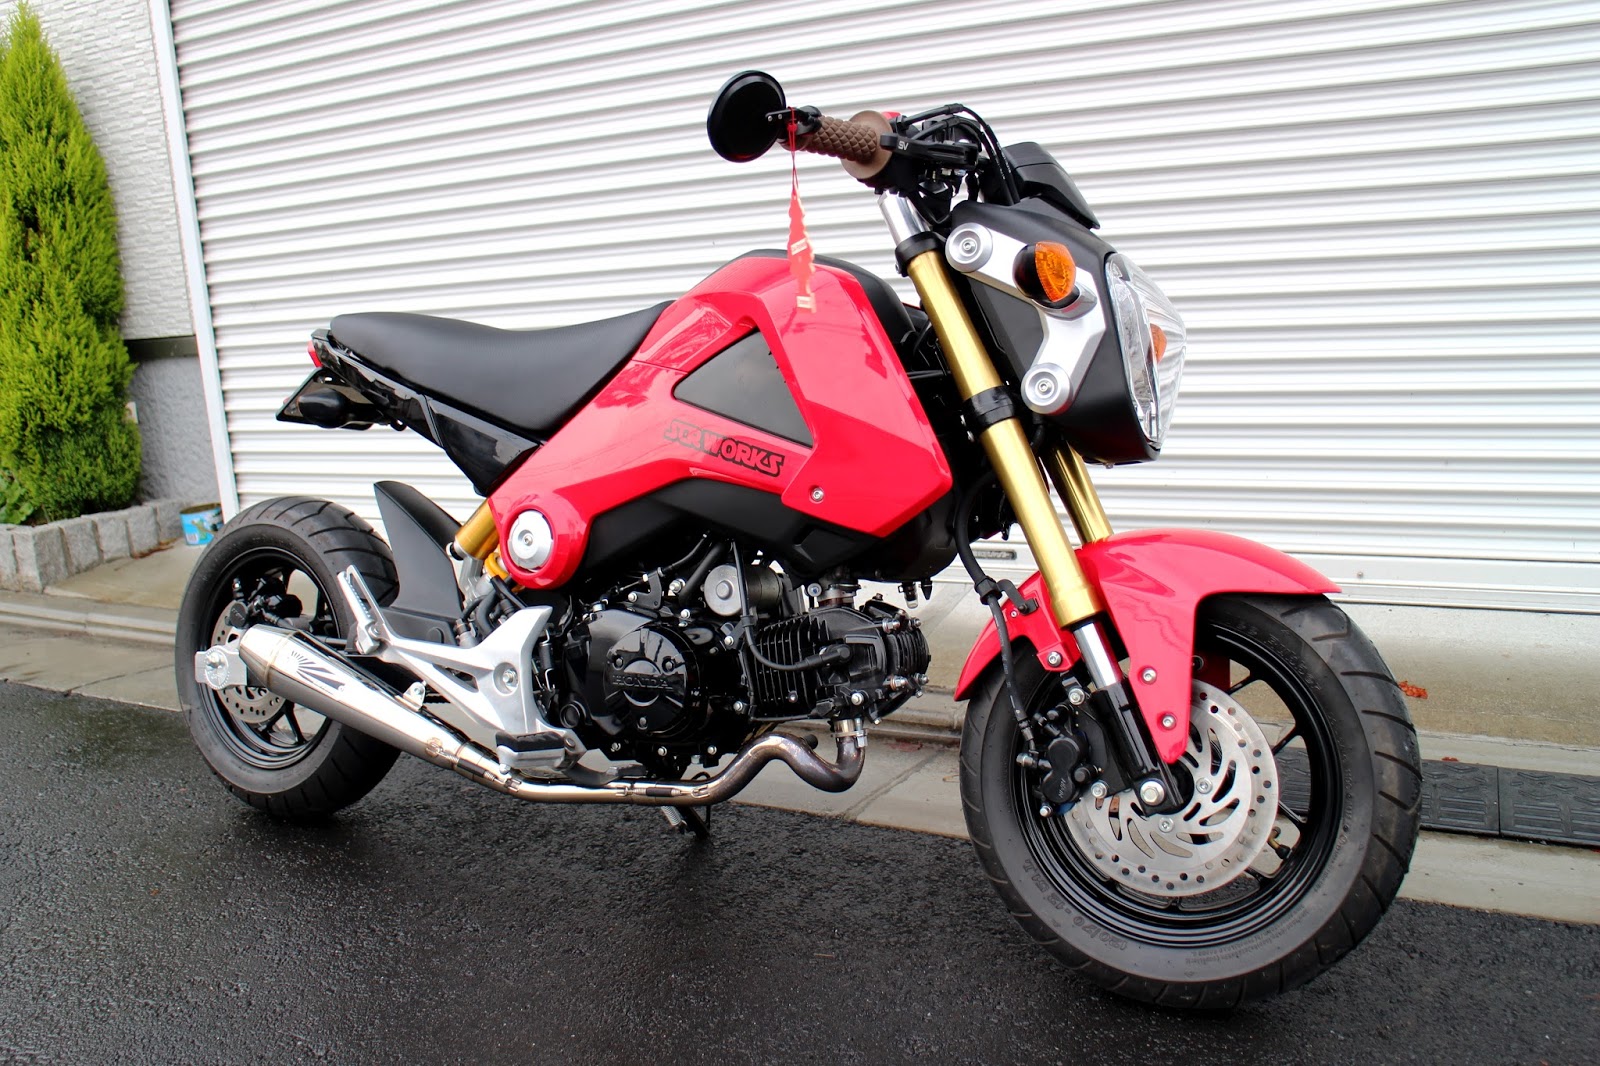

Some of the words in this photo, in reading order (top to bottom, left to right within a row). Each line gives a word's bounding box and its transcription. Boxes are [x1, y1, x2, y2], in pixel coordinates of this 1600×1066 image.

[898, 140, 909, 151] SV
[701, 429, 785, 477] WORKS
[612, 675, 674, 690] HONDA
